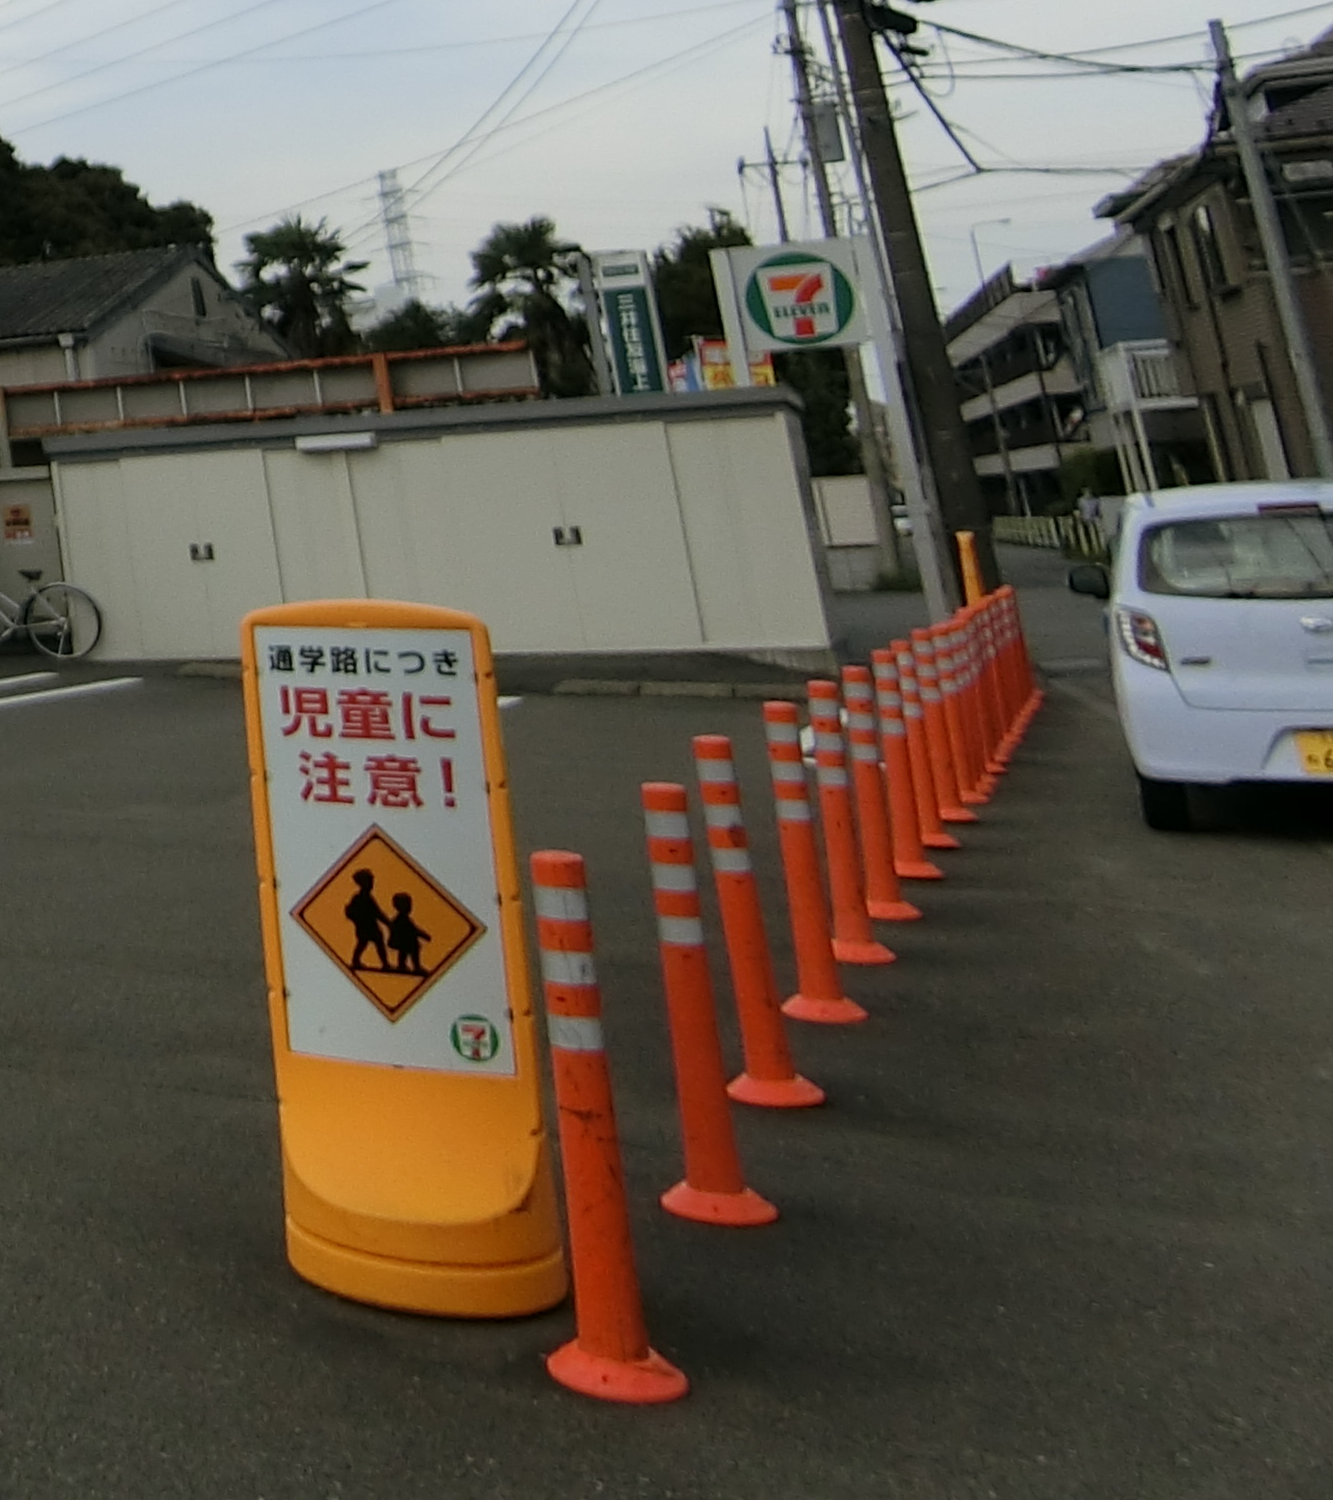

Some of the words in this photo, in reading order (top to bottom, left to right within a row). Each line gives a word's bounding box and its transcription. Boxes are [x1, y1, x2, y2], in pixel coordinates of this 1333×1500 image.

[269, 644, 458, 677] 通学路につき
[280, 684, 456, 741] 児童に
